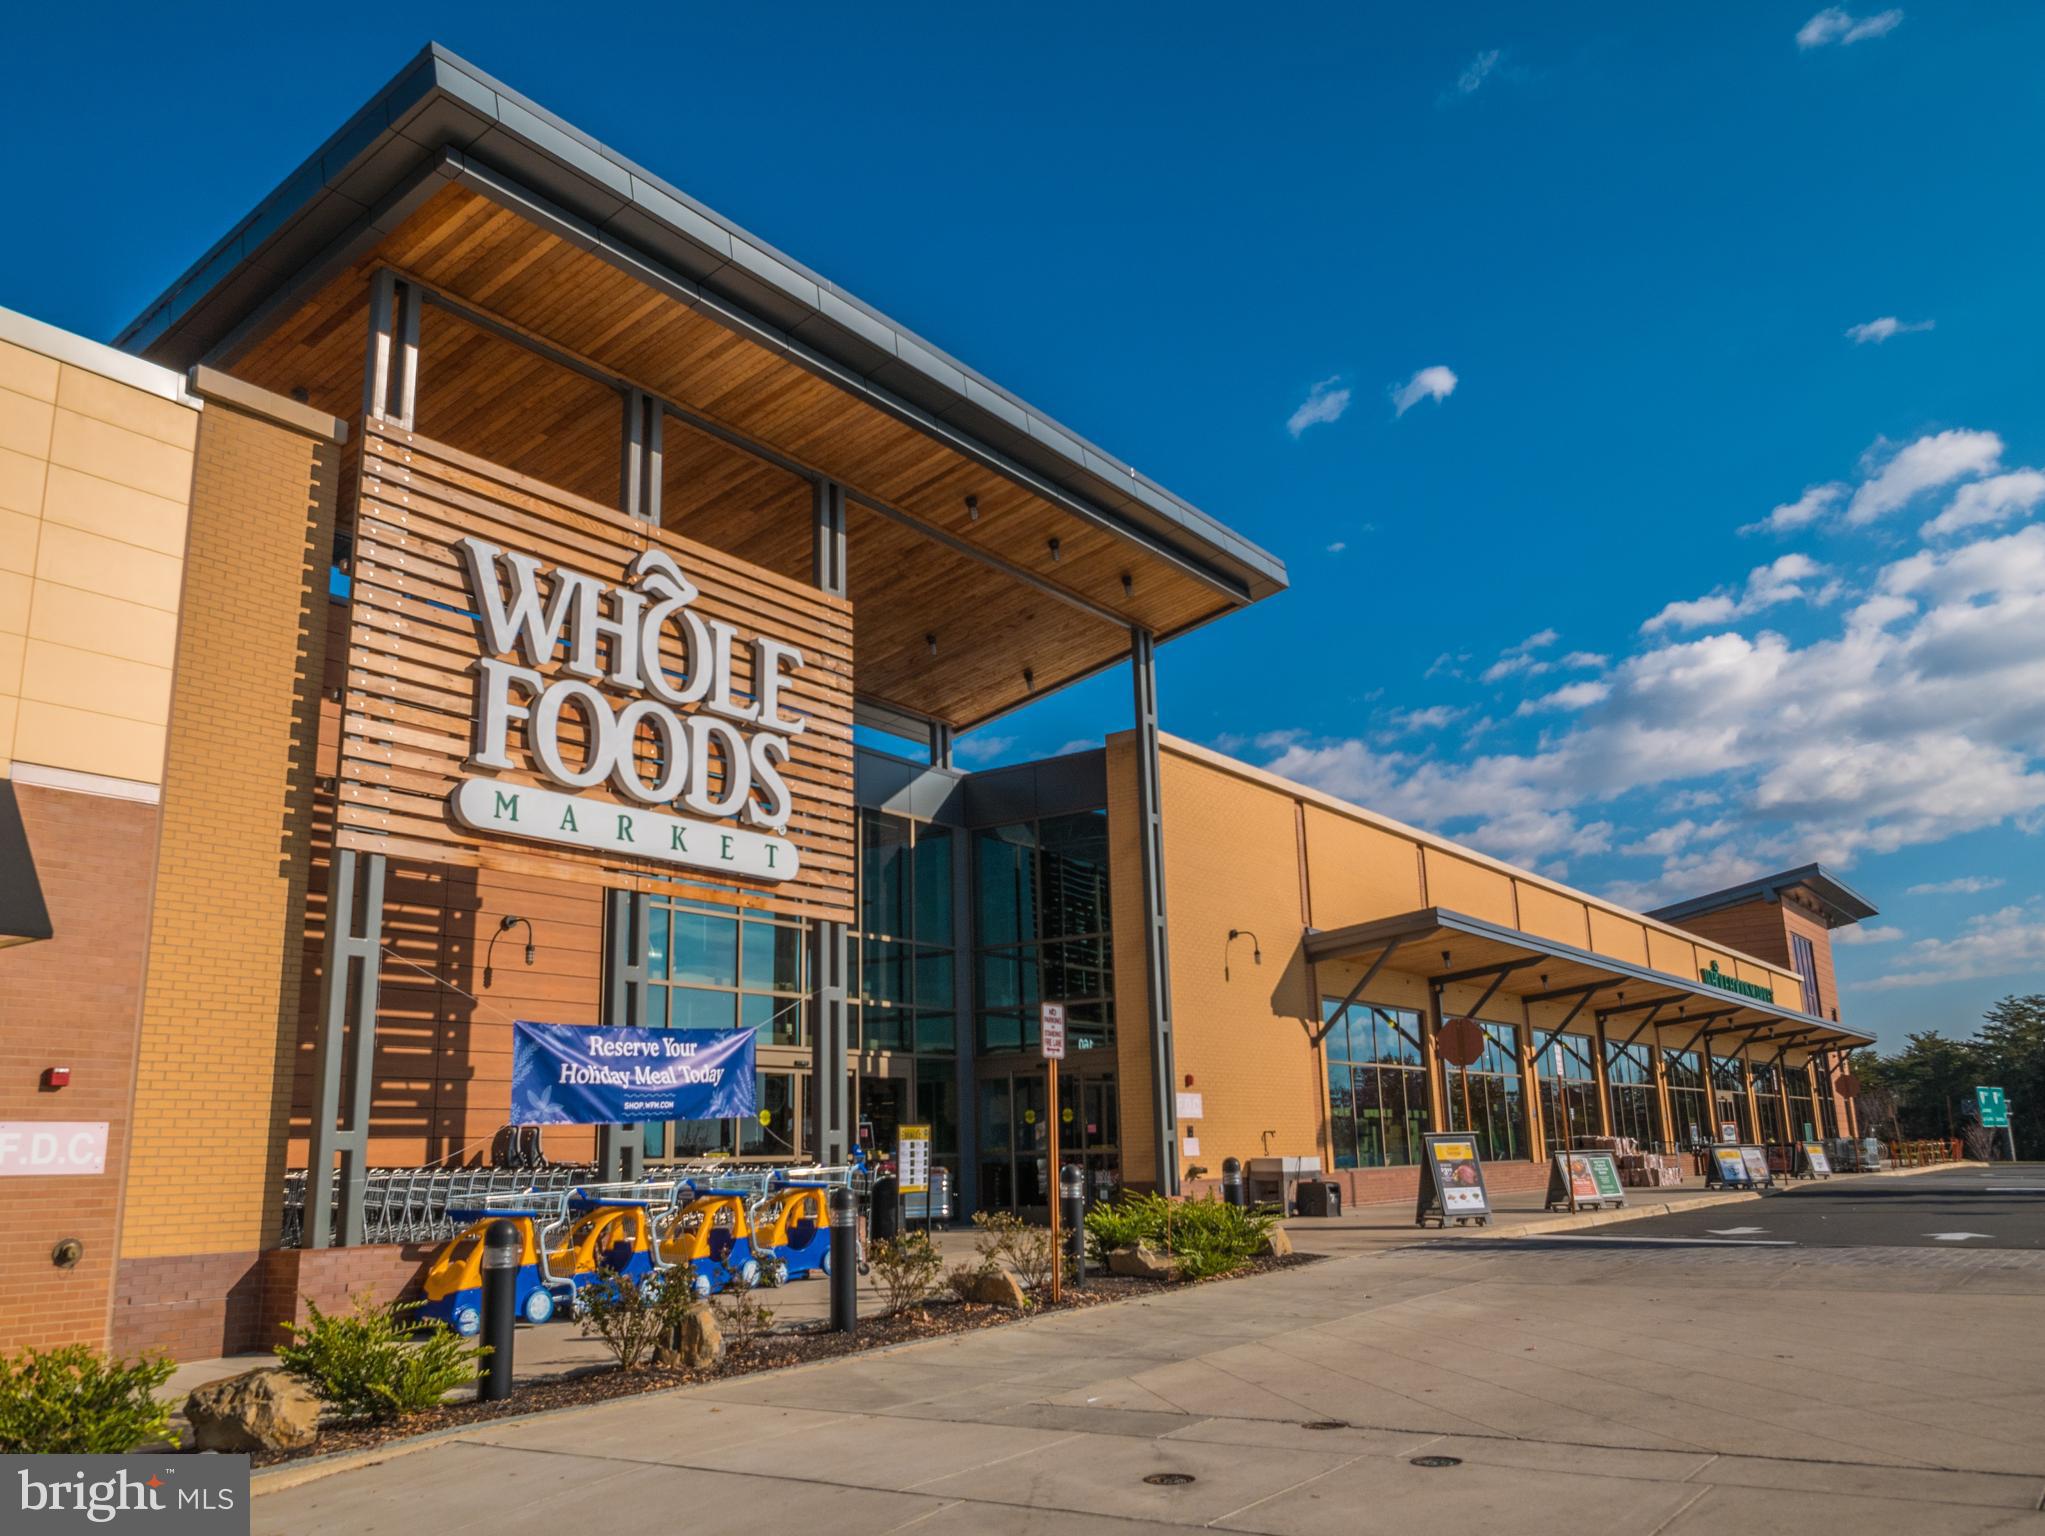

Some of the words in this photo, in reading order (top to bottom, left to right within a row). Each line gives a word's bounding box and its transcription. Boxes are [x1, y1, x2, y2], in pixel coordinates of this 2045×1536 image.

[456, 536, 806, 735] WHOLE
[466, 656, 794, 829] FOODS
[493, 790, 779, 869] MARKET
[558, 1063, 630, 1089] Holiday
[634, 1066, 677, 1085] Meal
[679, 1065, 725, 1087] Today
[590, 1035, 659, 1057] Reserve
[662, 1037, 697, 1057] Your
